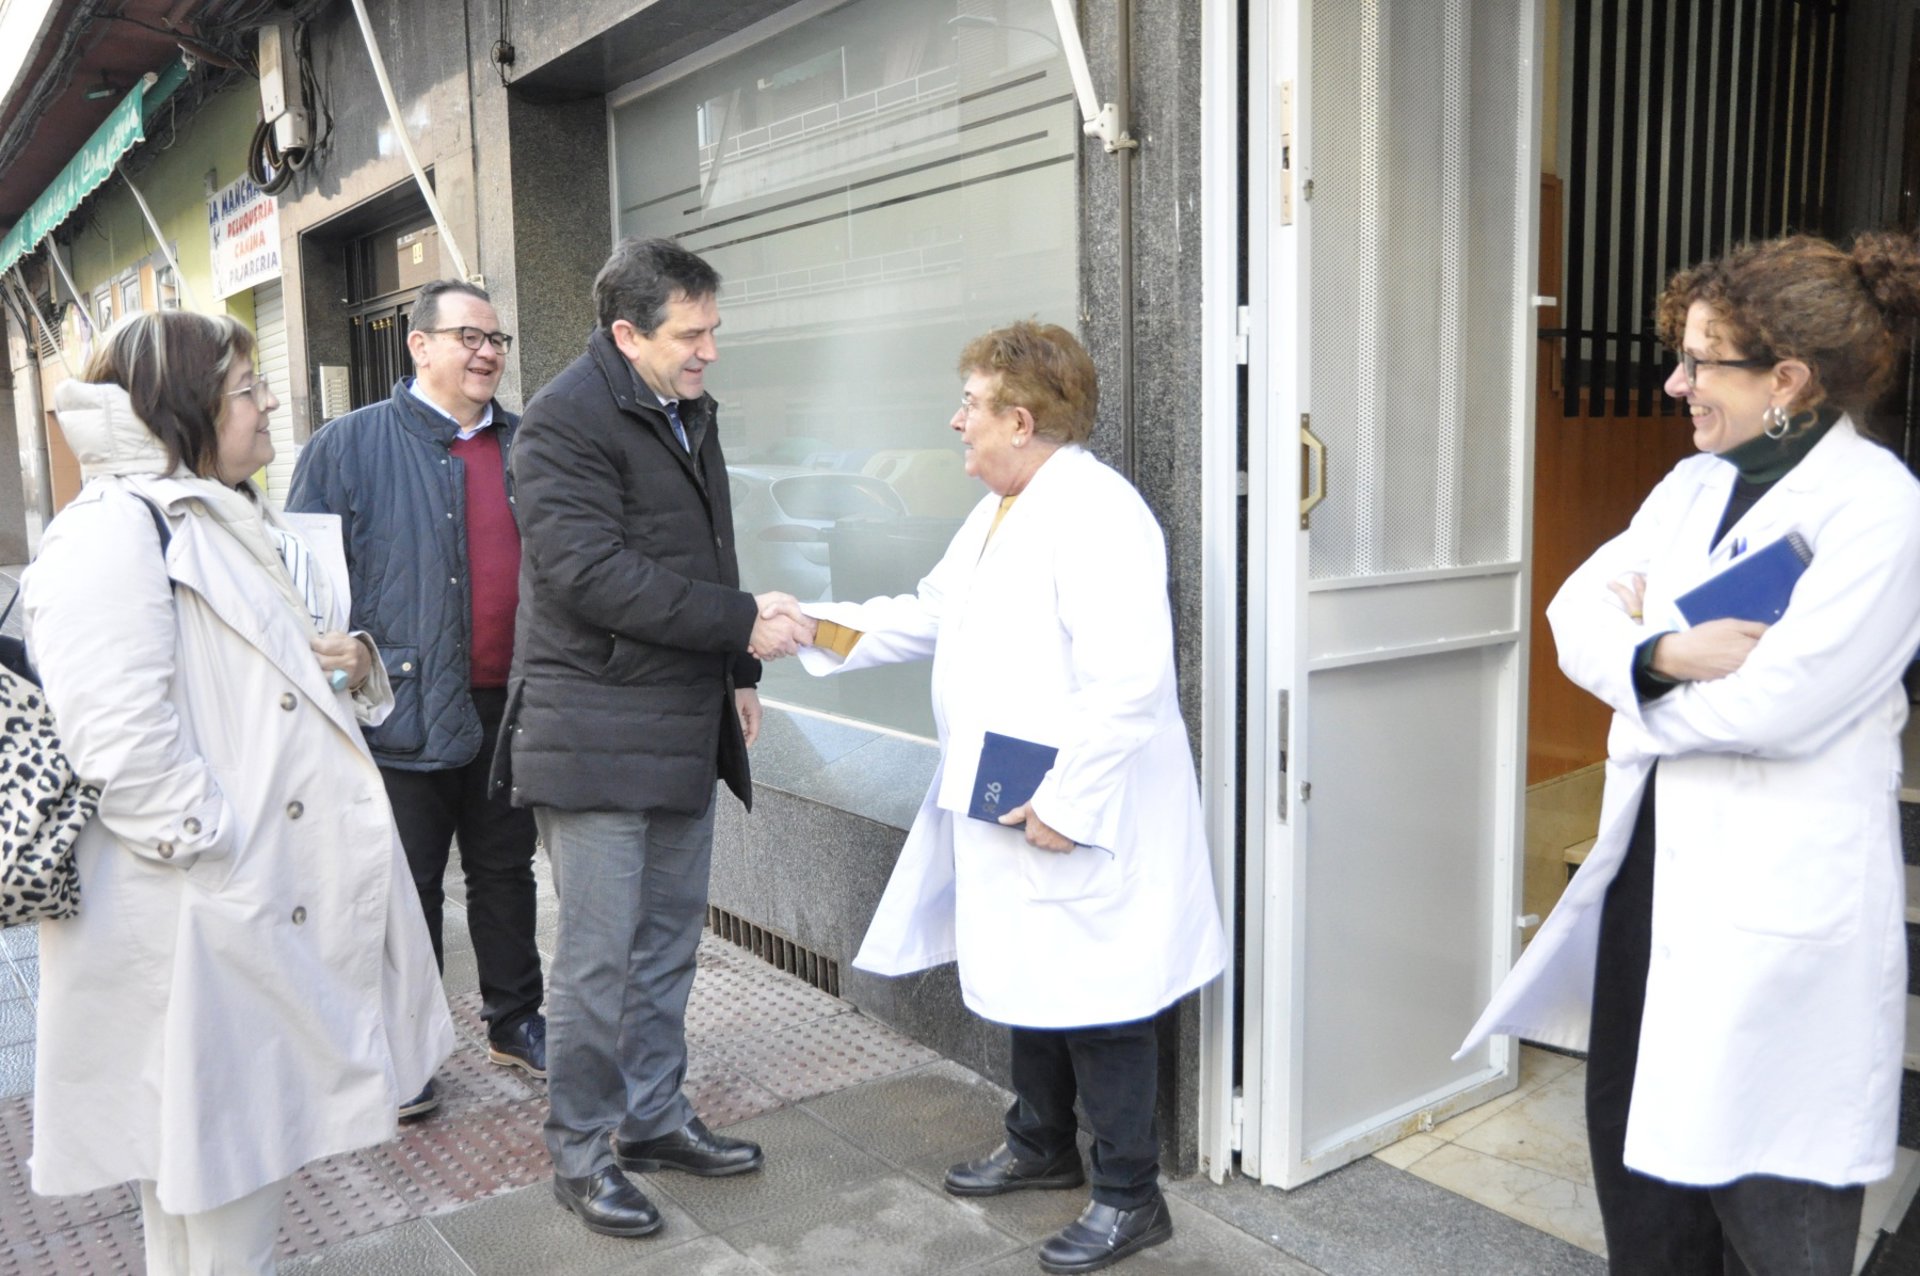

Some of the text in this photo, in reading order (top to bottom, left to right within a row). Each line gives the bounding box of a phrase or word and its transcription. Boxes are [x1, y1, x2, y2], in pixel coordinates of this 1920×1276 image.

[209, 201, 219, 225] LA
[227, 199, 274, 238] PELUQUERIA
[234, 230, 266, 258] CANINA
[230, 251, 278, 284] PAJARERIA
[984, 782, 1002, 804] 26
